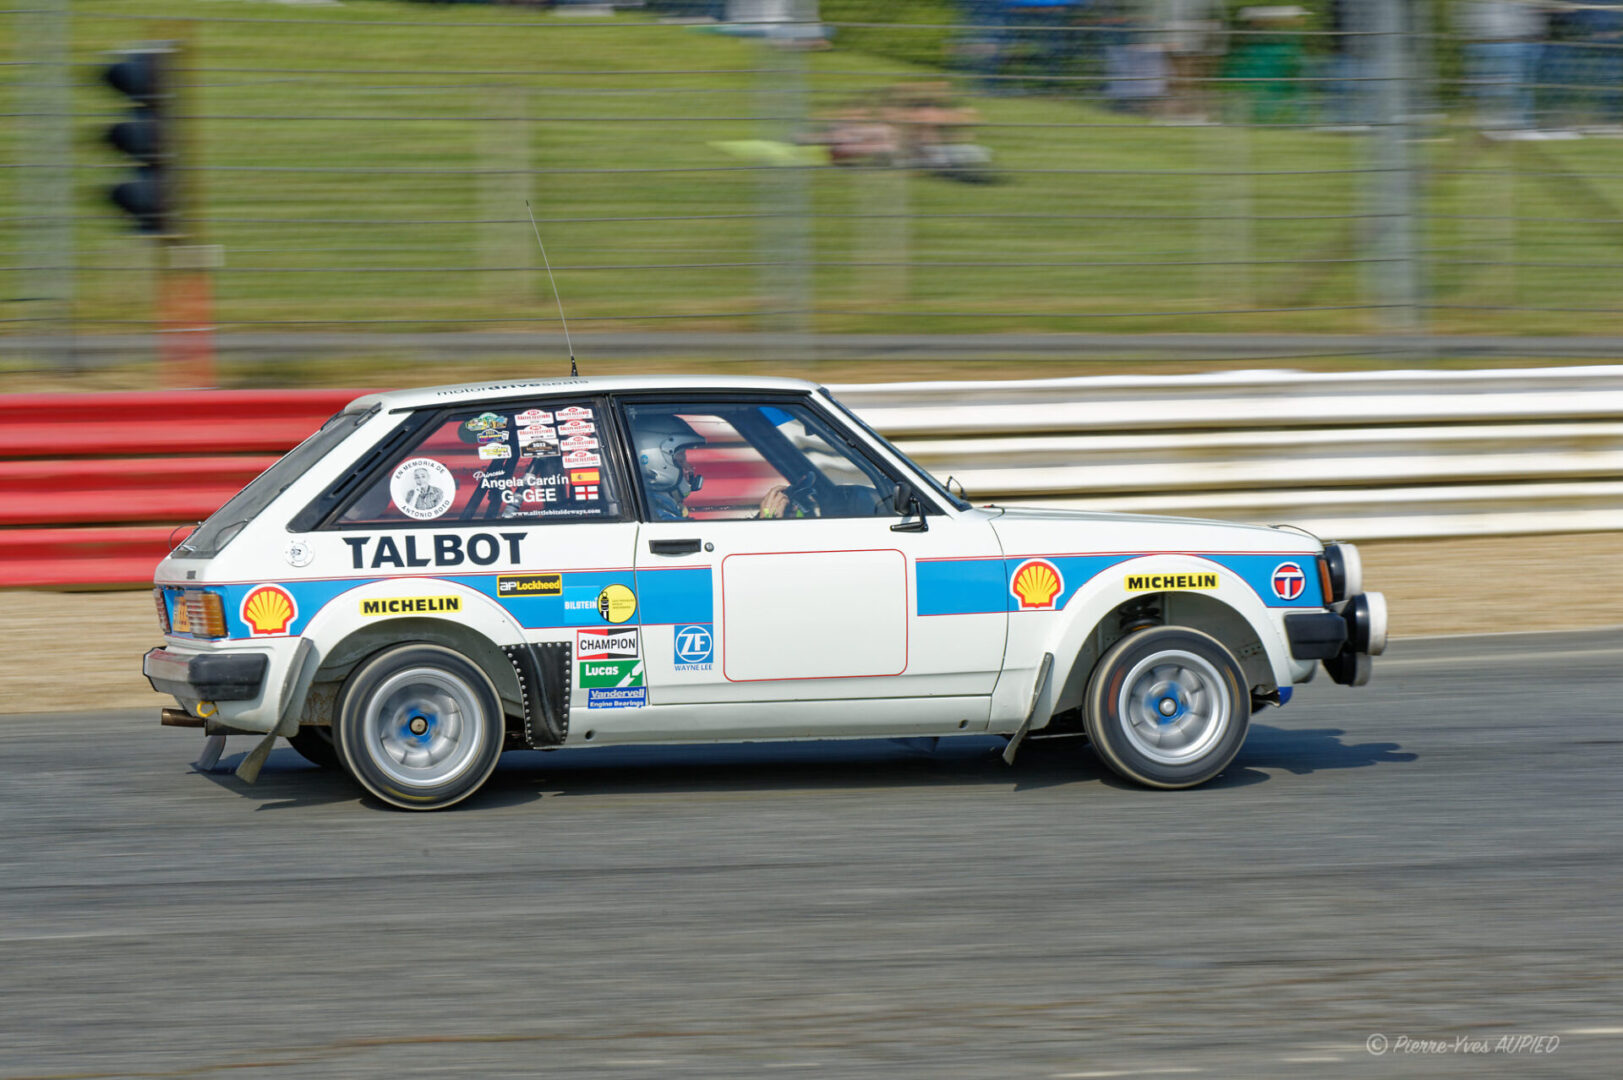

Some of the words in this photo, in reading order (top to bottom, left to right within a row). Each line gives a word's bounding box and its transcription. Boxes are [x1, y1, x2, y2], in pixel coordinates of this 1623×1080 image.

[403, 461, 435, 471] MEMORIA
[436, 465, 445, 474] DE
[481, 476, 524, 490] Angela
[526, 474, 569, 486] Cardín
[501, 490, 519, 504] G.
[522, 488, 557, 502] GEE
[401, 505, 433, 518] ANTONIO
[342, 532, 528, 569] TALBOT
[1128, 575, 1216, 589] MICHELIN
[363, 598, 459, 614] MICHELIN
[564, 600, 597, 610] BILSTEIN
[580, 638, 636, 650] CHAMPION
[680, 633, 709, 655] ZF
[585, 664, 619, 676] Lucas
[591, 688, 645, 700] Vandervell
[614, 700, 644, 708] Bearings
